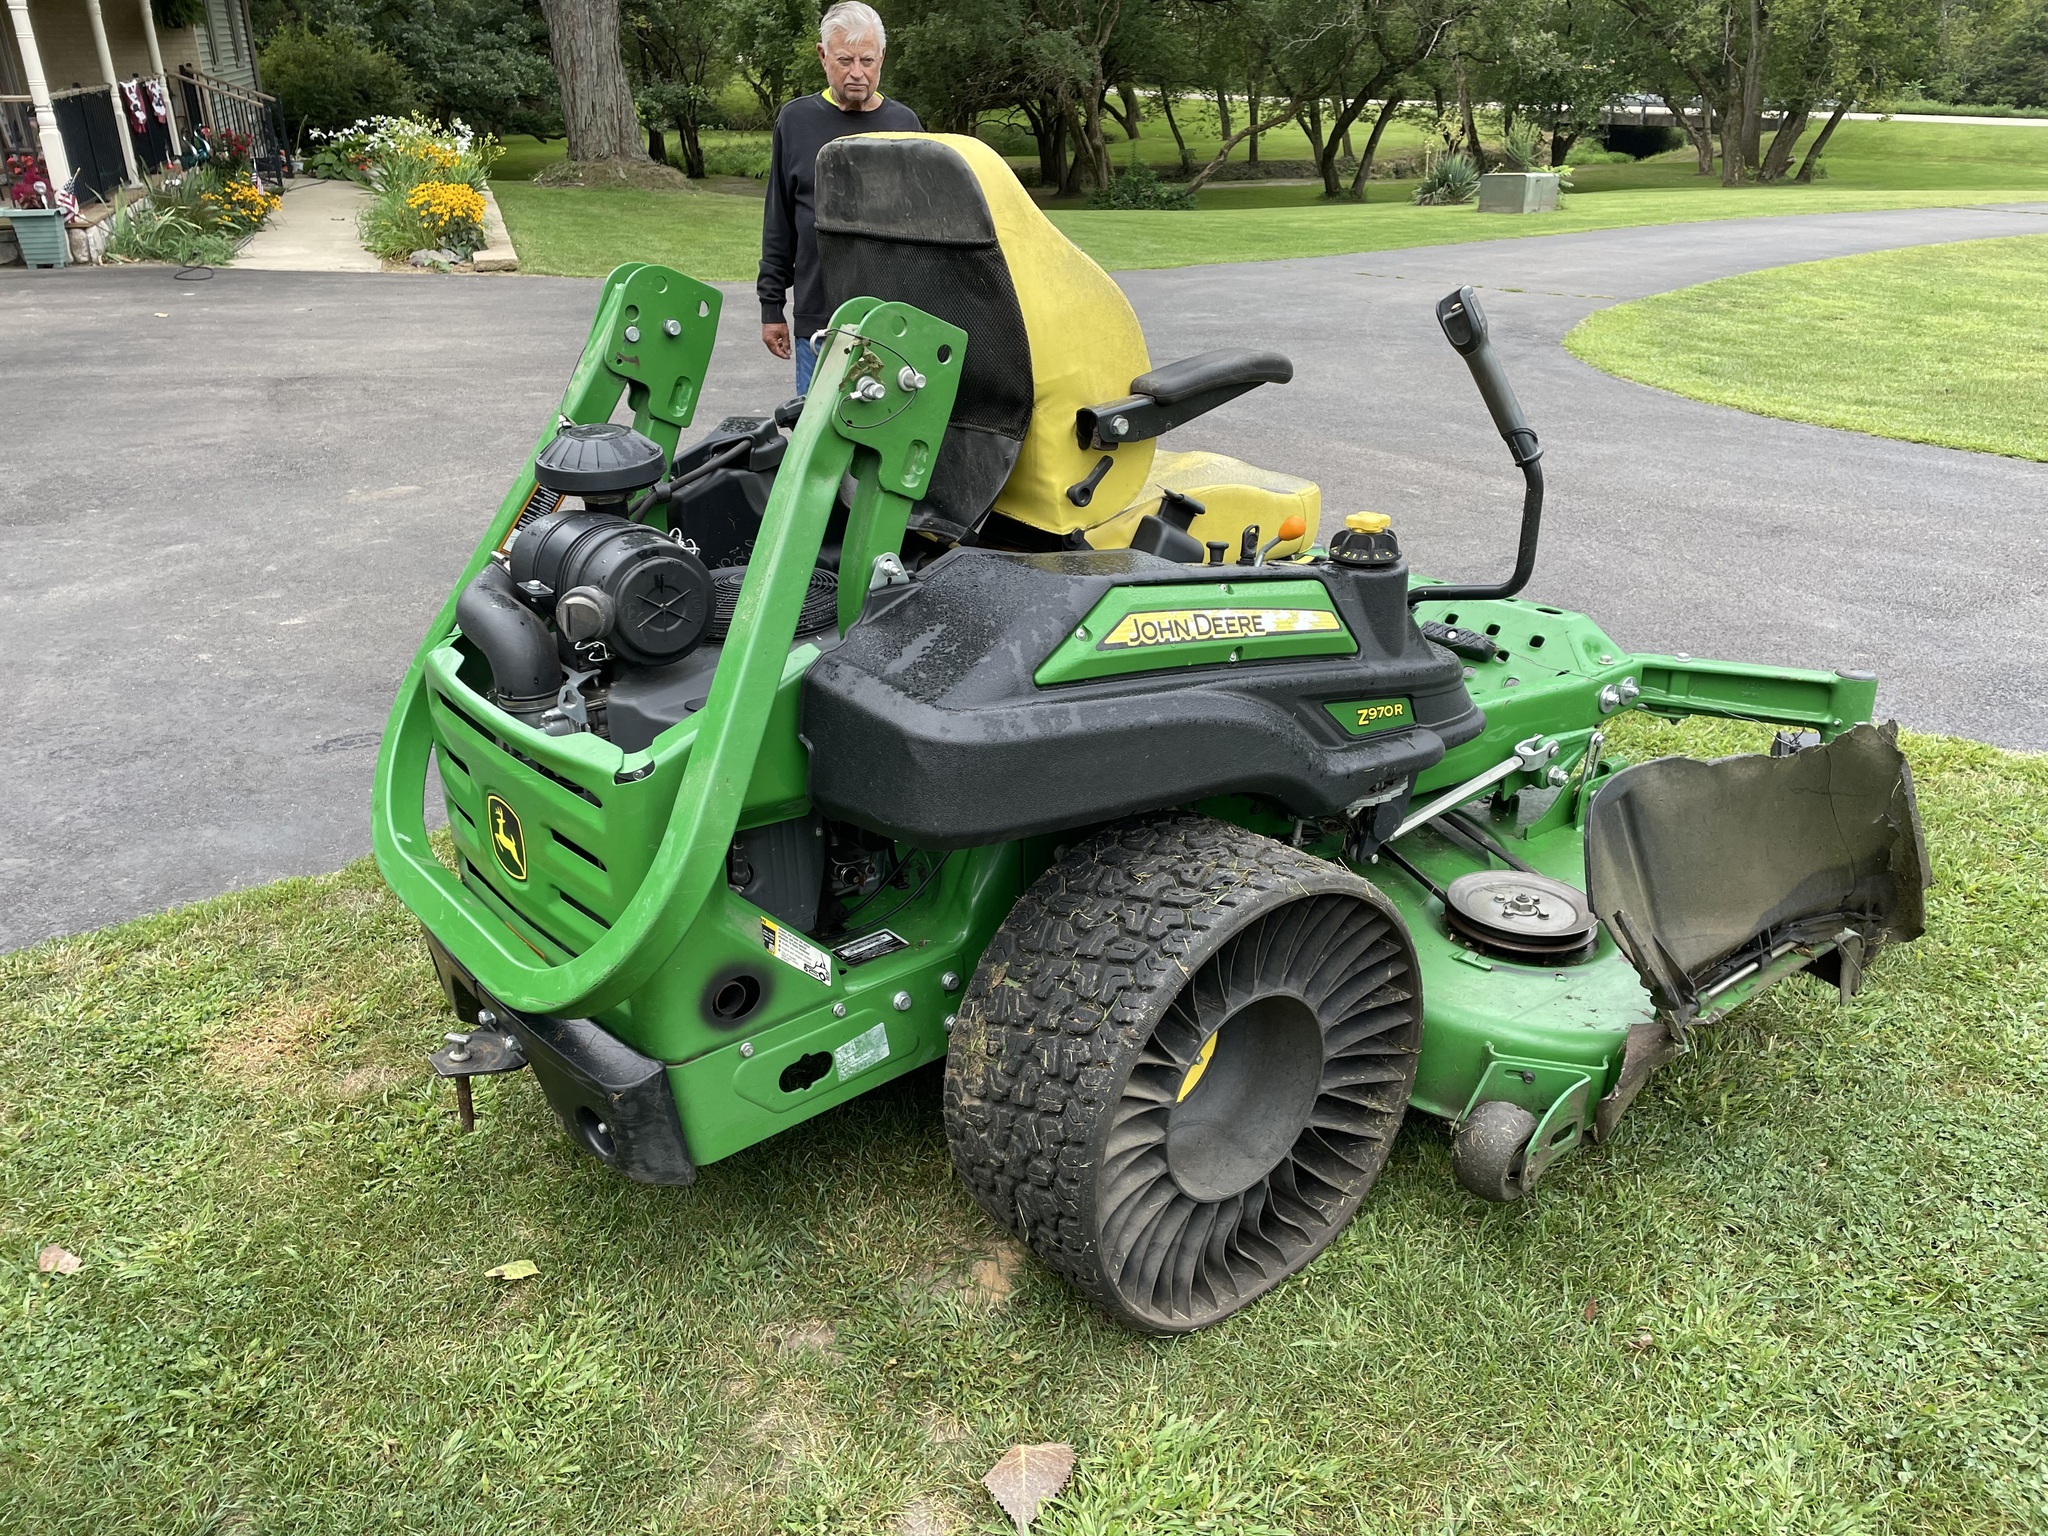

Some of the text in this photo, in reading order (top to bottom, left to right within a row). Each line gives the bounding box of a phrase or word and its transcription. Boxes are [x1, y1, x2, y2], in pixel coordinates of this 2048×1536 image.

[1129, 614, 1266, 642] JOHN DEERE
[1357, 703, 1404, 726] Z970R
